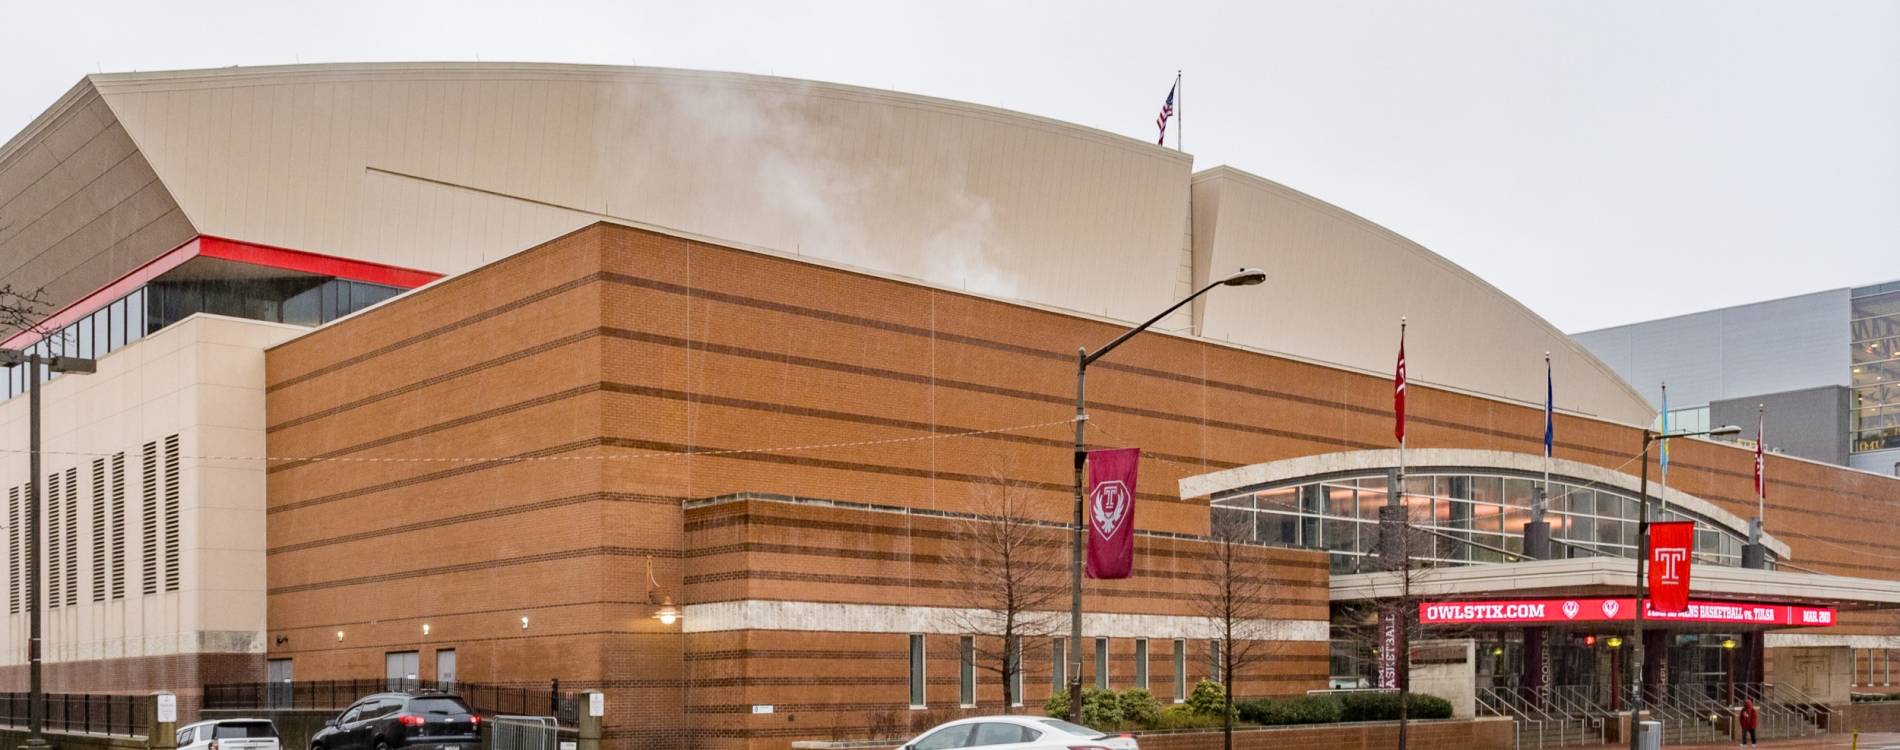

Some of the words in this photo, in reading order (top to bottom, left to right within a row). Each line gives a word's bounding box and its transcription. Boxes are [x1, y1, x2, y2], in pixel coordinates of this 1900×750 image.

[1103, 486, 1118, 509] T
[1655, 547, 1686, 580] T
[1427, 604, 1545, 620] OWLSTIX.COM
[1700, 605, 1743, 619] BASKETBALL
[1754, 607, 1775, 621] TULSA
